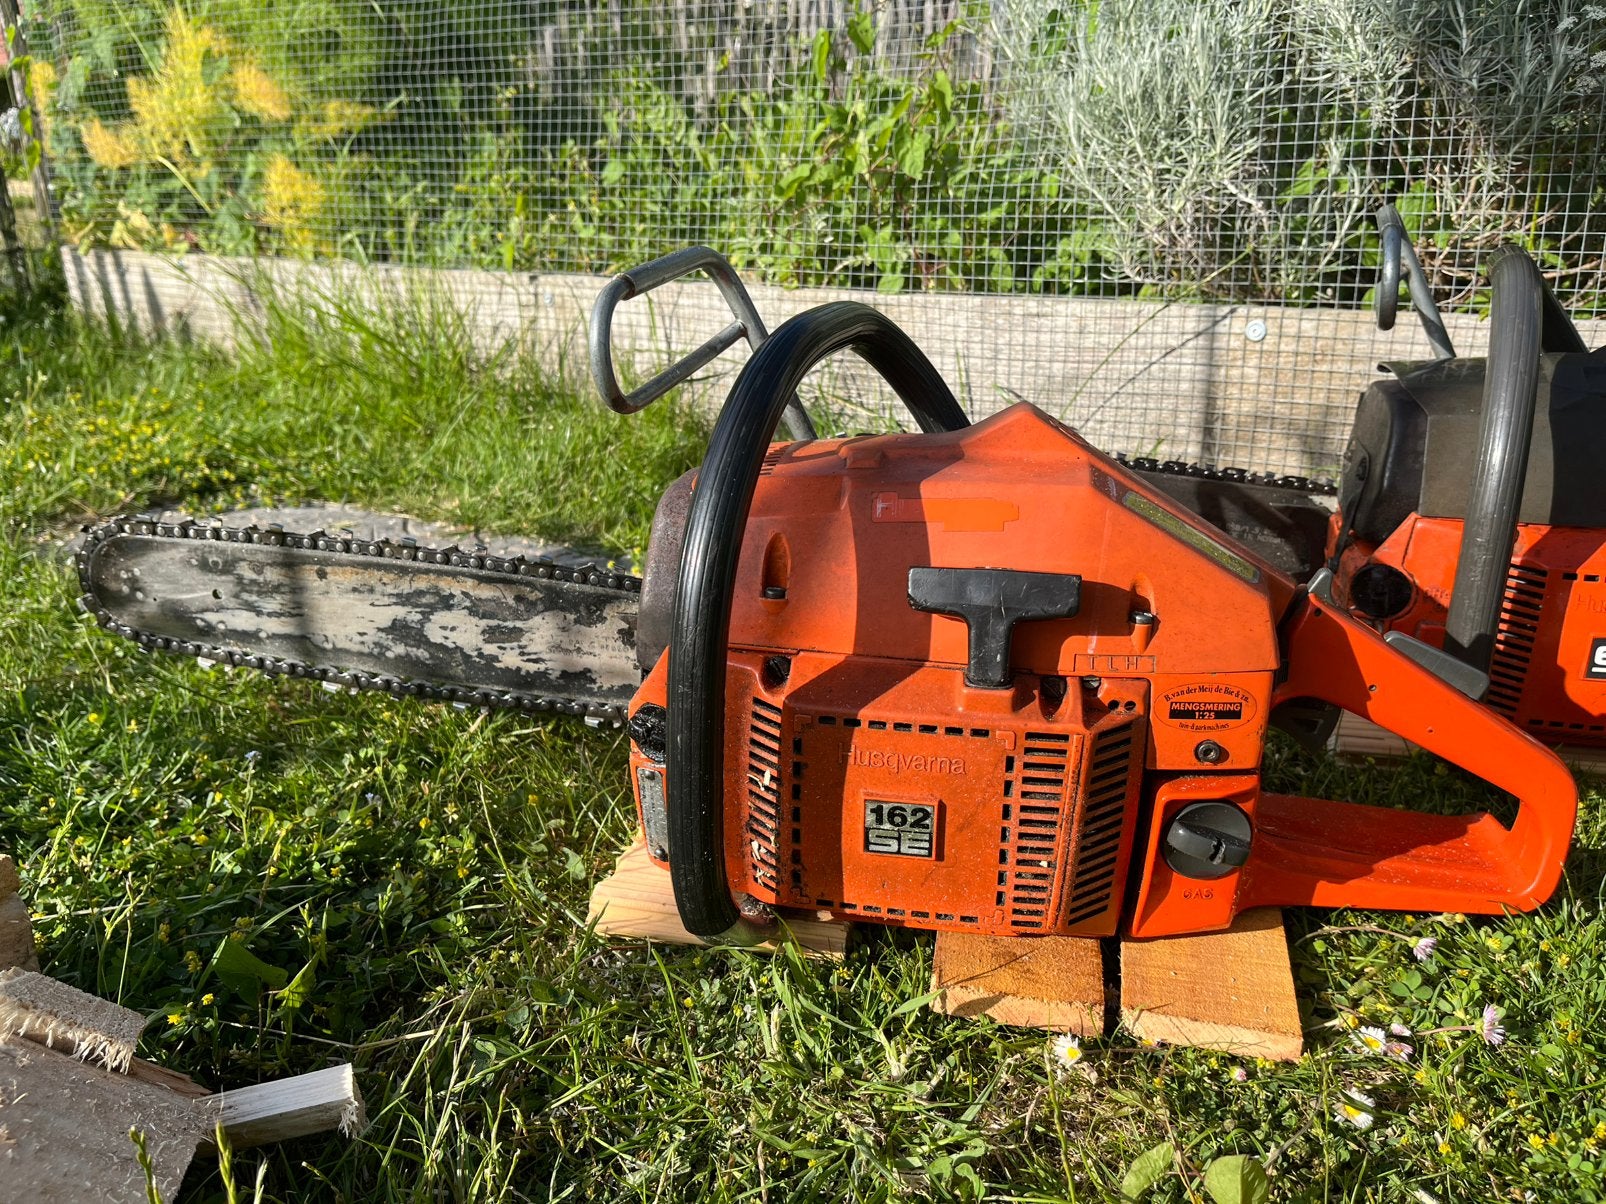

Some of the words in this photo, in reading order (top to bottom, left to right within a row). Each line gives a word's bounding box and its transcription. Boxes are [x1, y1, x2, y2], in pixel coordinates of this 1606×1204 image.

[1172, 689, 1185, 699] van
[1186, 686, 1198, 695] der
[1215, 685, 1223, 694] de
[1224, 686, 1235, 696] Bie
[1171, 702, 1241, 711] MENGSMERING
[1195, 711, 1216, 719] 1:25
[838, 742, 968, 775] Husqvarna
[869, 804, 933, 830] 162
[867, 829, 931, 856] SE
[1183, 888, 1214, 900] GAS
